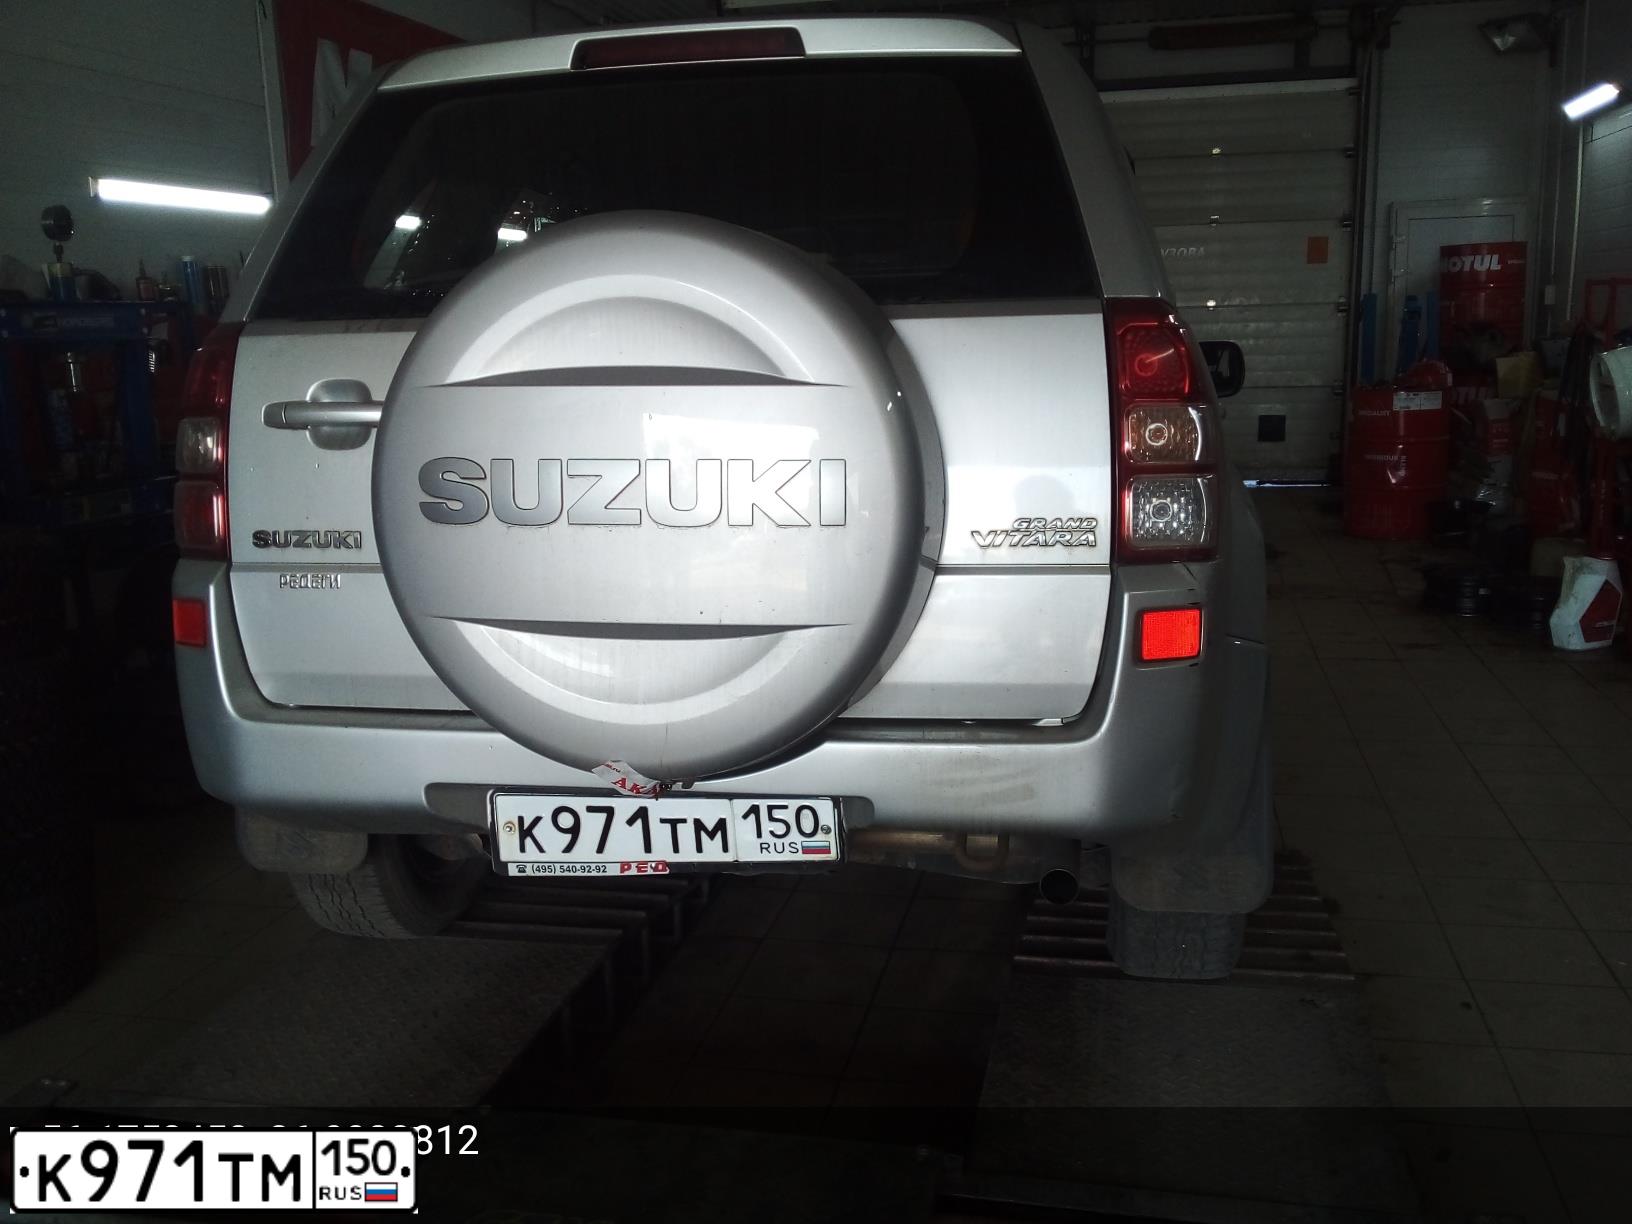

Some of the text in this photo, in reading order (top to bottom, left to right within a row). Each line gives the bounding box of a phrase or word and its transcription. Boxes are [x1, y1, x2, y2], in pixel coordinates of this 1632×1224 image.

[418, 456, 847, 528] SUZUKI
[1012, 517, 1098, 530] GRAND
[252, 529, 362, 549] SUZUKI
[971, 530, 1097, 549] VITARA
[741, 803, 820, 840] 150
[759, 841, 799, 855] RUS
[531, 864, 608, 875] (495) 540-92-92
